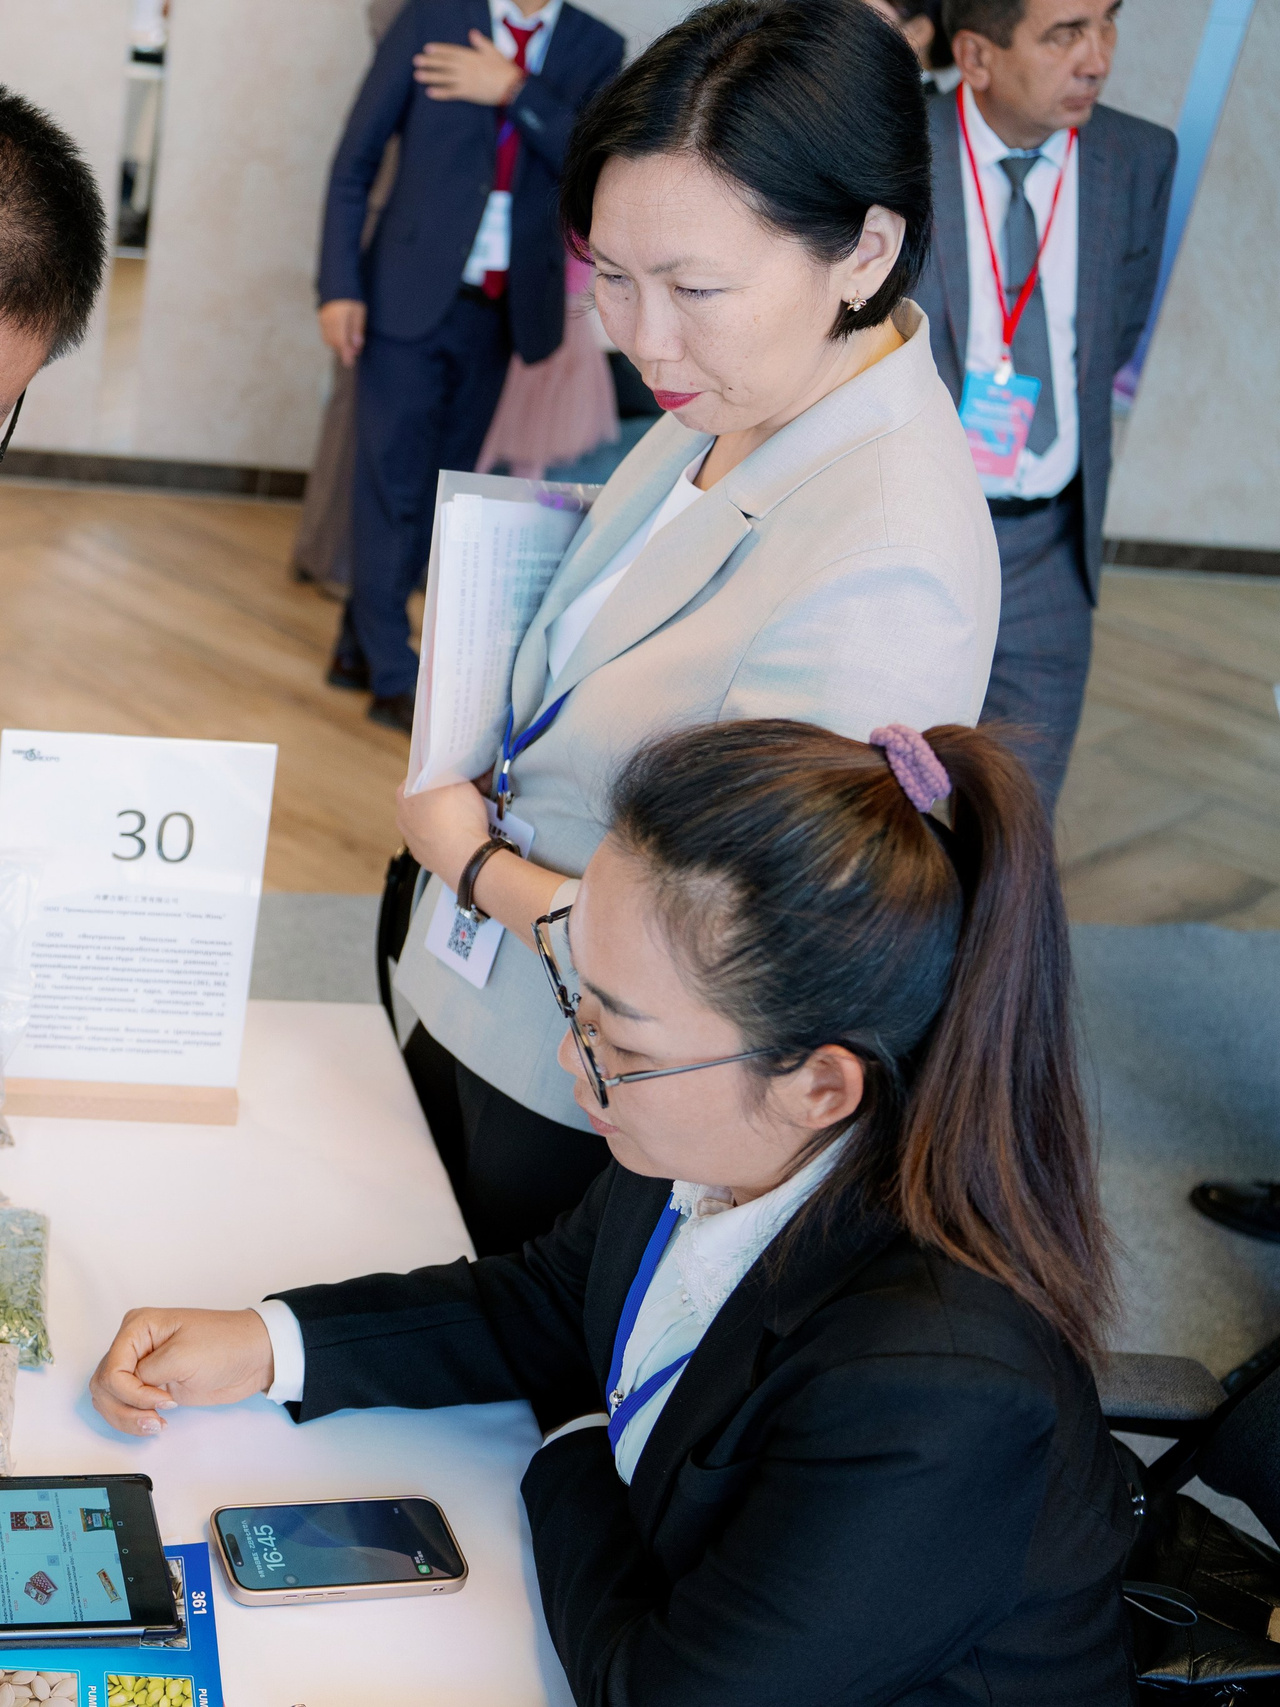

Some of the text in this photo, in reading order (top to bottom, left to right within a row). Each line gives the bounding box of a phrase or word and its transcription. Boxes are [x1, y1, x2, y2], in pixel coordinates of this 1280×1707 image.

[112, 809, 194, 864] 30
[253, 1524, 286, 1571] 16:45
[191, 1591, 208, 1615] 361
